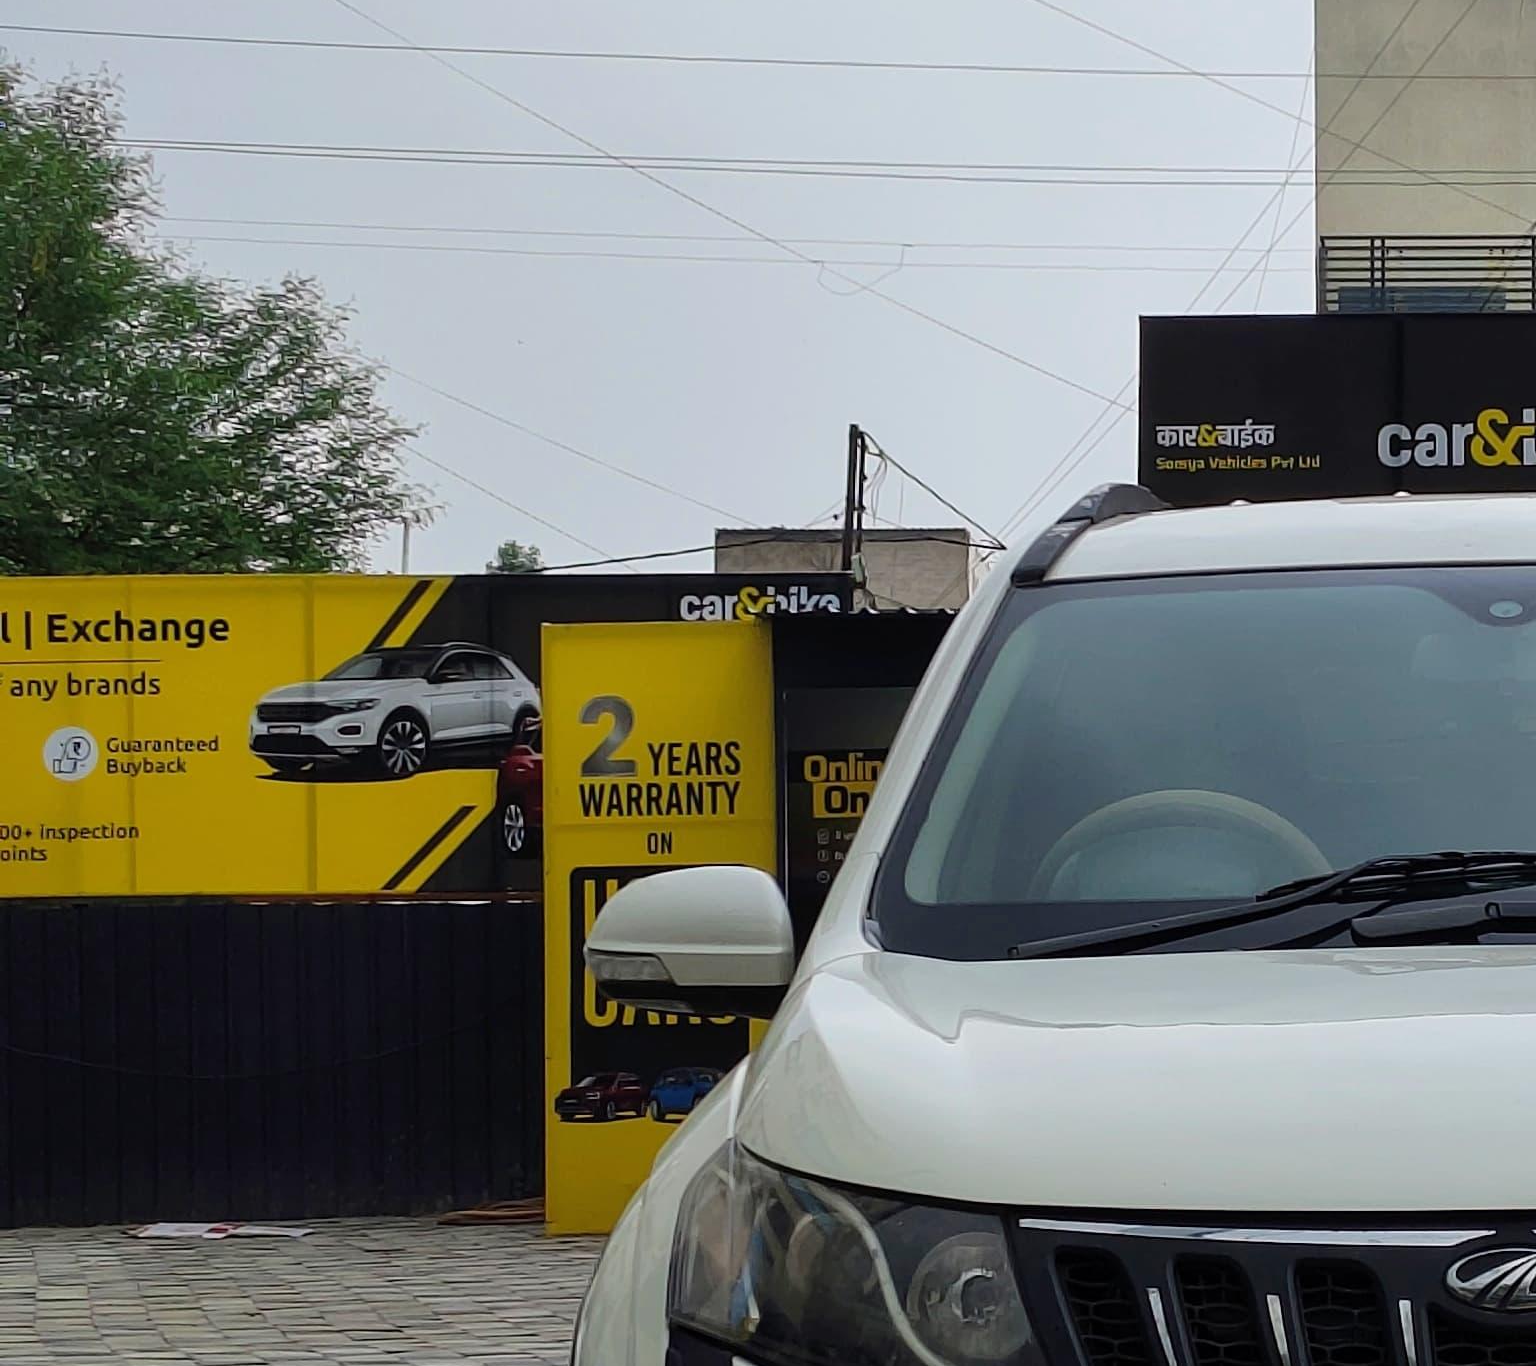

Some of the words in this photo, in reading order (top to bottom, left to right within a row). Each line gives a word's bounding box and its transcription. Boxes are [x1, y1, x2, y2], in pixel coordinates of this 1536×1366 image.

[47, 610, 229, 648] Exchange
[10, 679, 58, 701] any
[67, 671, 161, 696] brands
[106, 736, 219, 752] Guaranteed
[580, 695, 637, 777] 2
[648, 742, 741, 776] YEARS
[106, 757, 187, 776] Buyback
[578, 781, 741, 817] WARRANTY
[40, 823, 140, 842] inspection
[647, 831, 673, 854] ON
